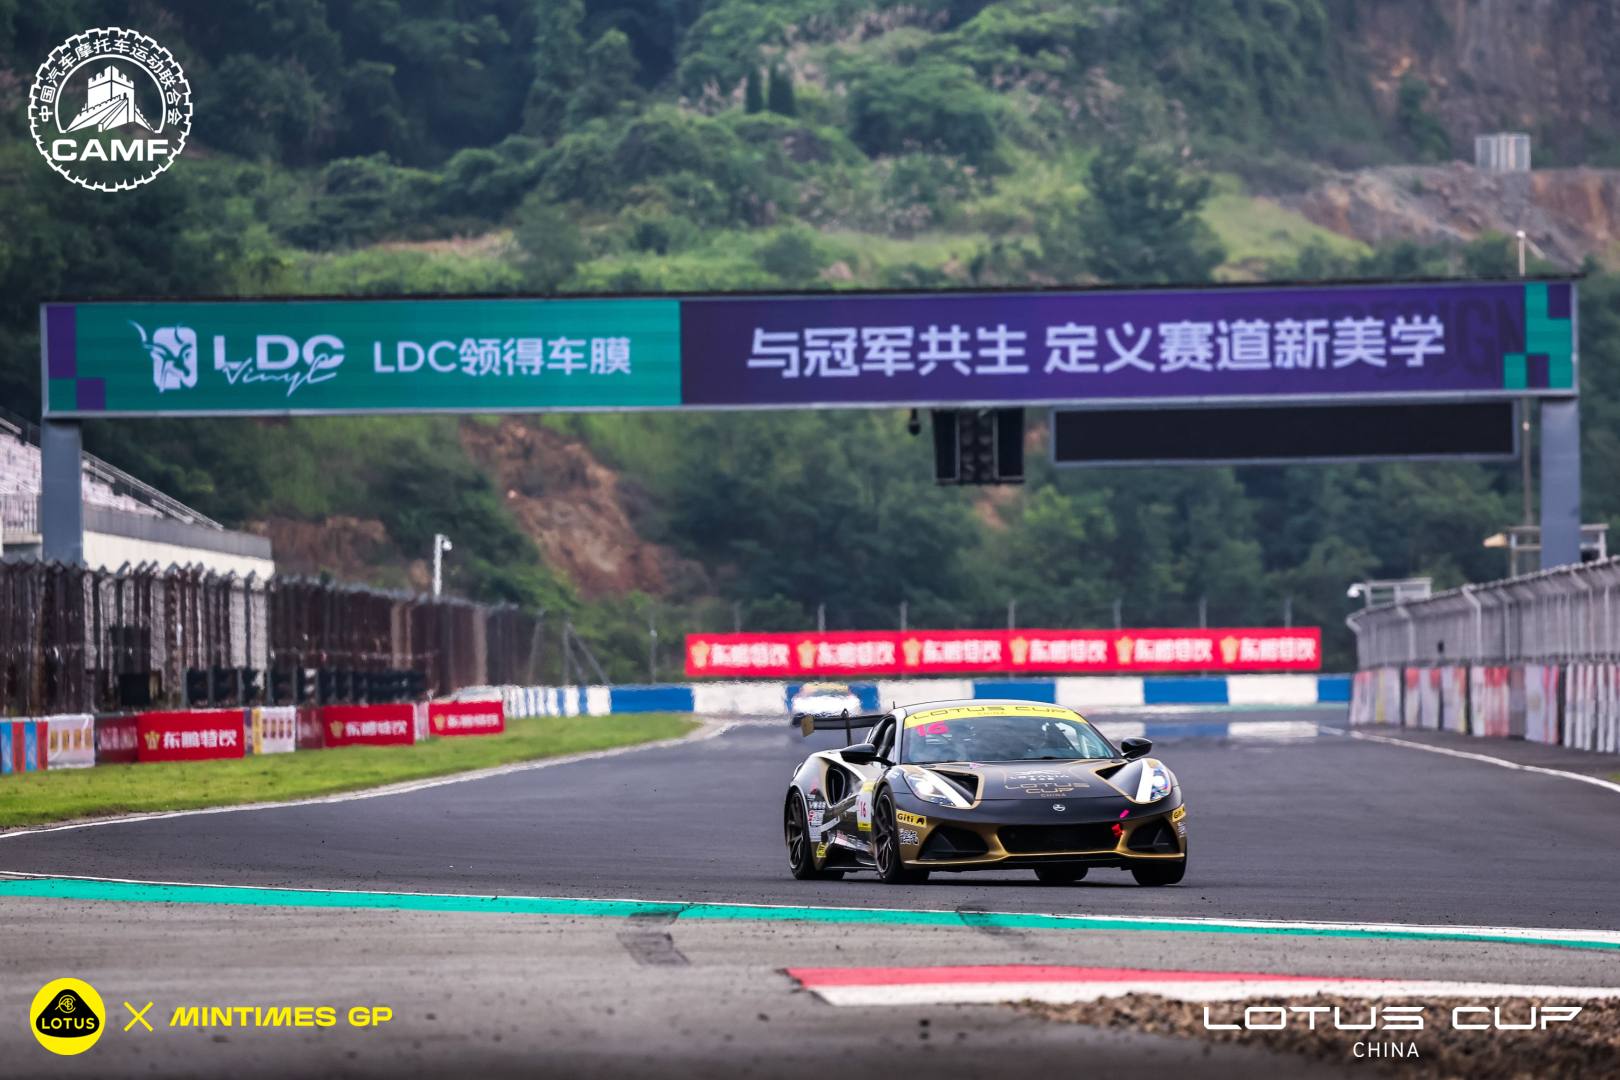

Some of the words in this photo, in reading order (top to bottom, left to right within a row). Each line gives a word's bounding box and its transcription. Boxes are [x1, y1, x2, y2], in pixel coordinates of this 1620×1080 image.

[213, 334, 345, 370] LDC
[747, 324, 1029, 378] 与冠军共生
[1043, 314, 1445, 374] 定义赛道新美学
[914, 706, 1005, 719] LOTUS
[916, 720, 949, 737] 16
[163, 729, 237, 749] 东鹏特饮
[897, 813, 914, 822] Giti
